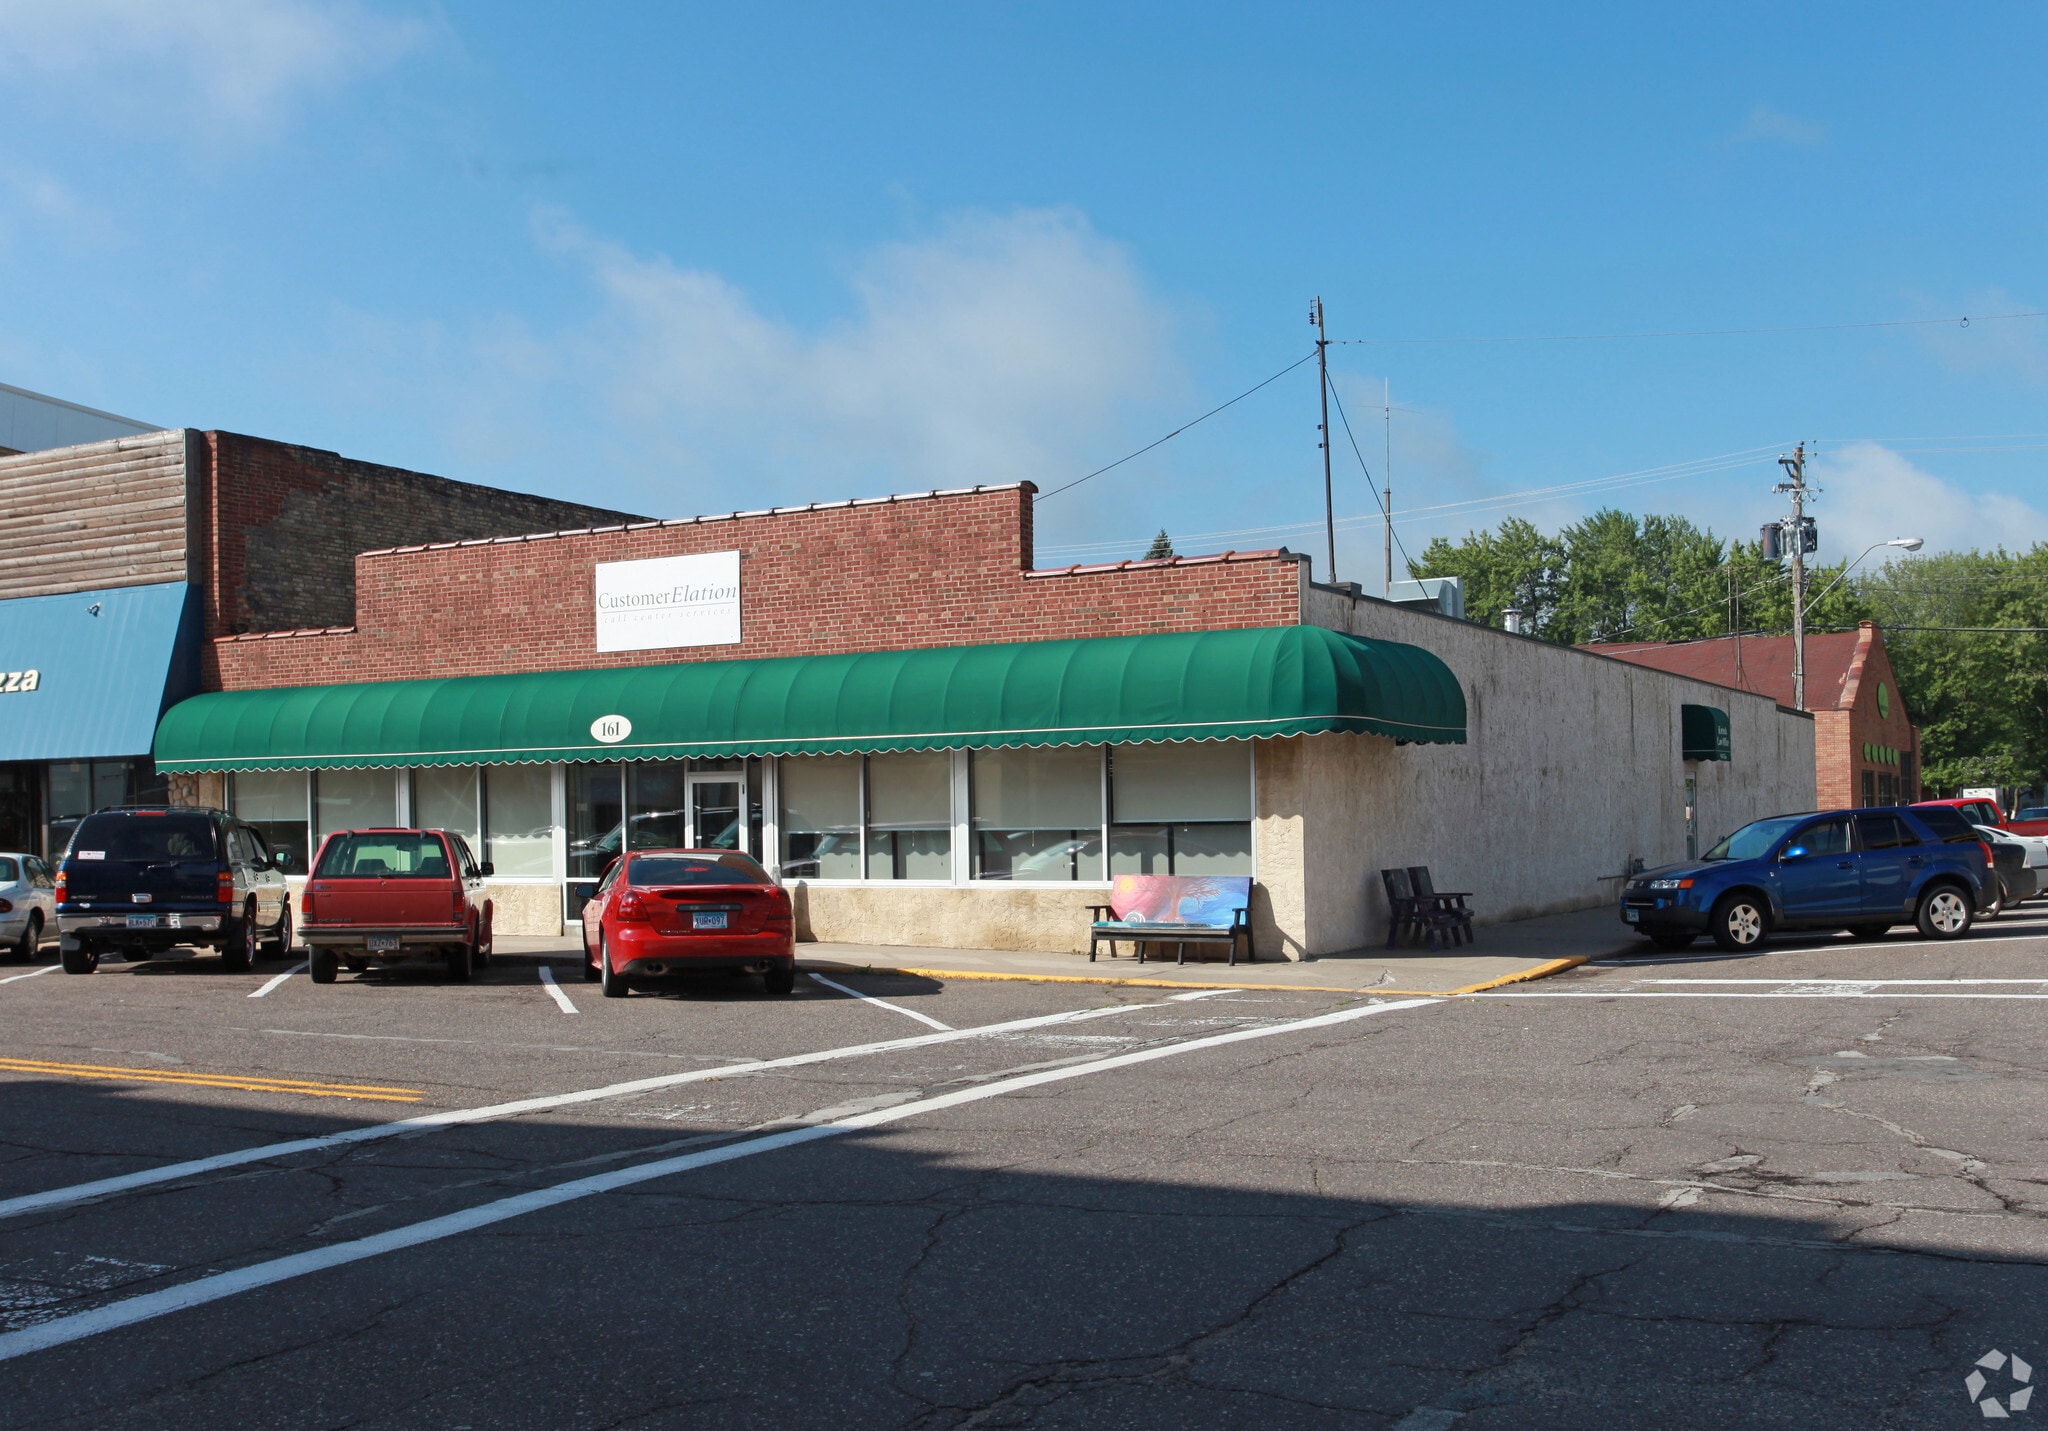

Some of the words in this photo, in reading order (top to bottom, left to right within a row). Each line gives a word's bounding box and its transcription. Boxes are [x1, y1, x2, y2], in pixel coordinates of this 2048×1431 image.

[604, 614, 627, 624] call
[634, 611, 672, 622] center
[680, 606, 732, 618] services
[602, 722, 620, 737] 161
